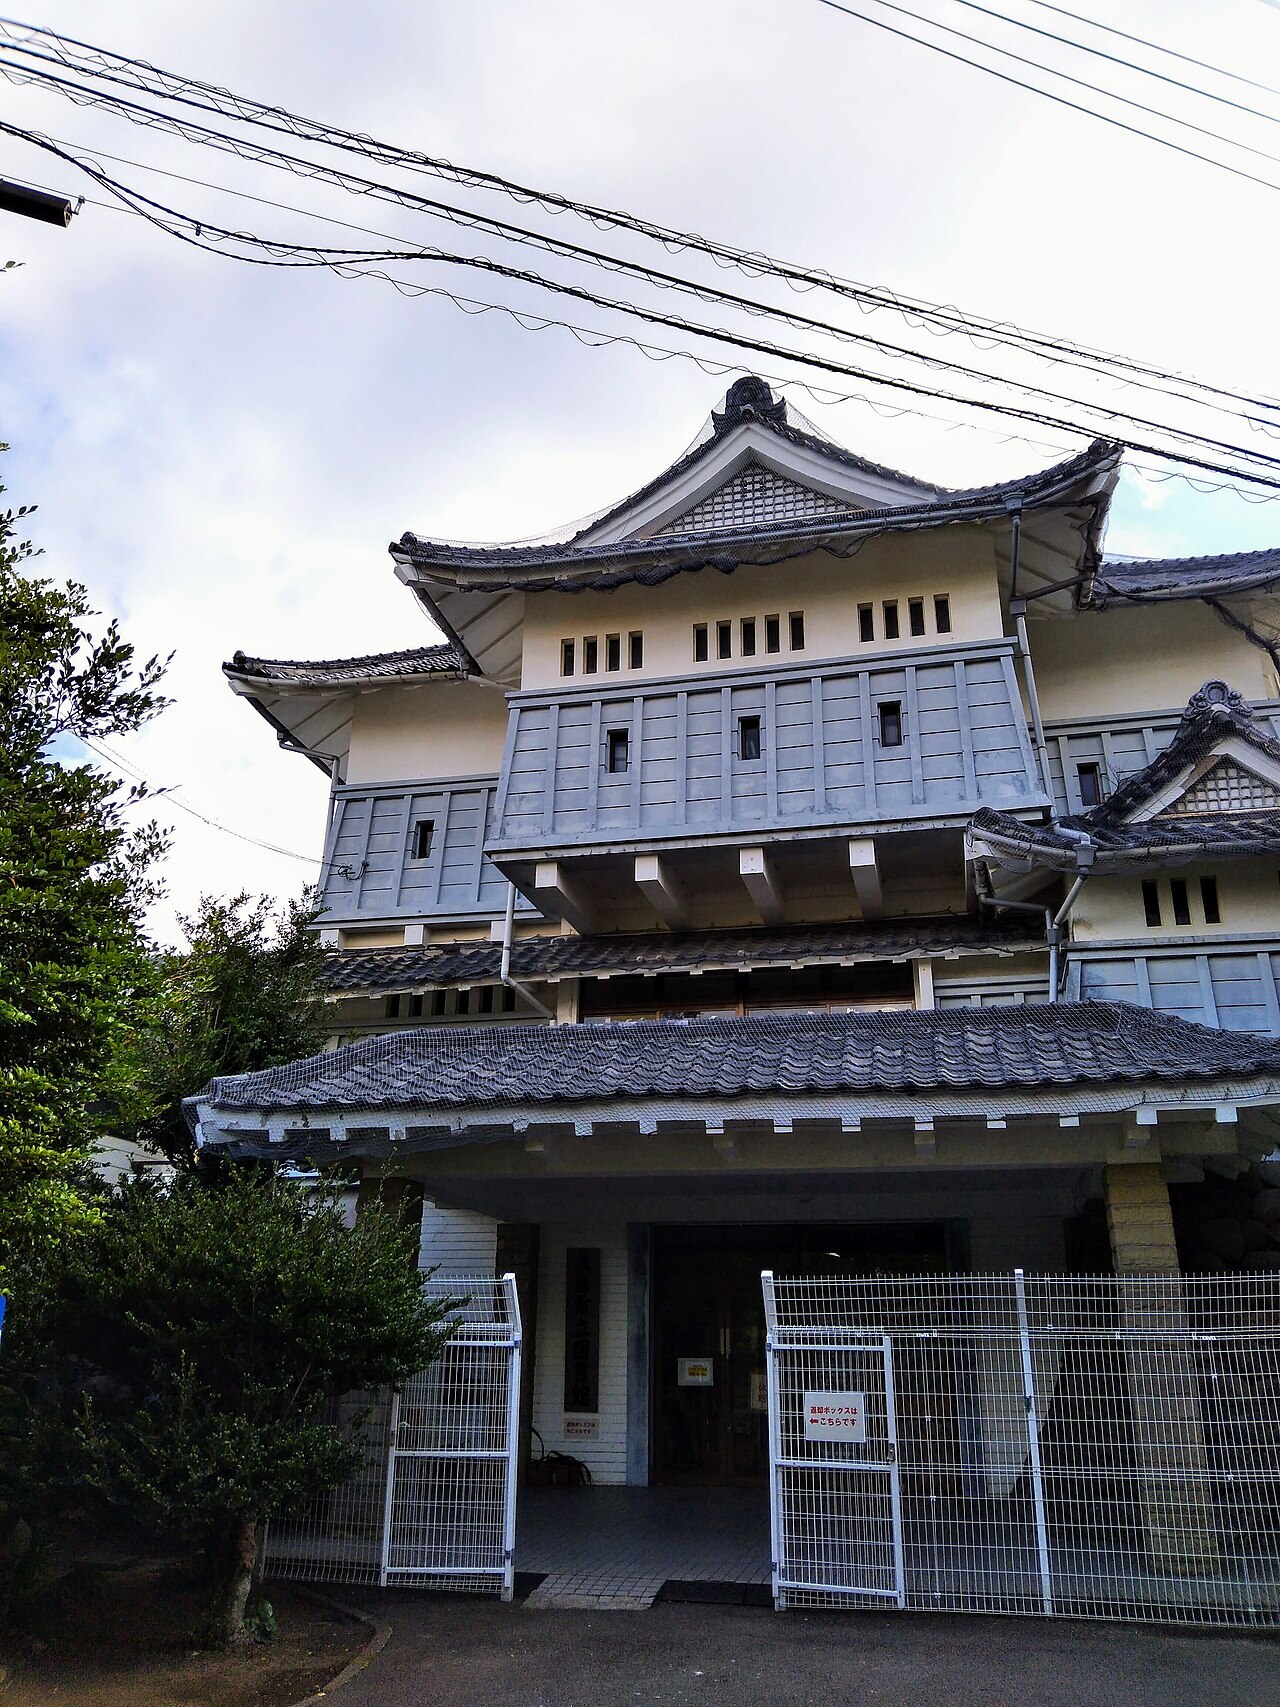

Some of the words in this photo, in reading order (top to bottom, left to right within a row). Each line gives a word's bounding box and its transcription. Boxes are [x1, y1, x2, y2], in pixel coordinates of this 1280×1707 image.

[810, 1406, 858, 1415] 返却ボックスは
[820, 1417, 857, 1427] こちらです
